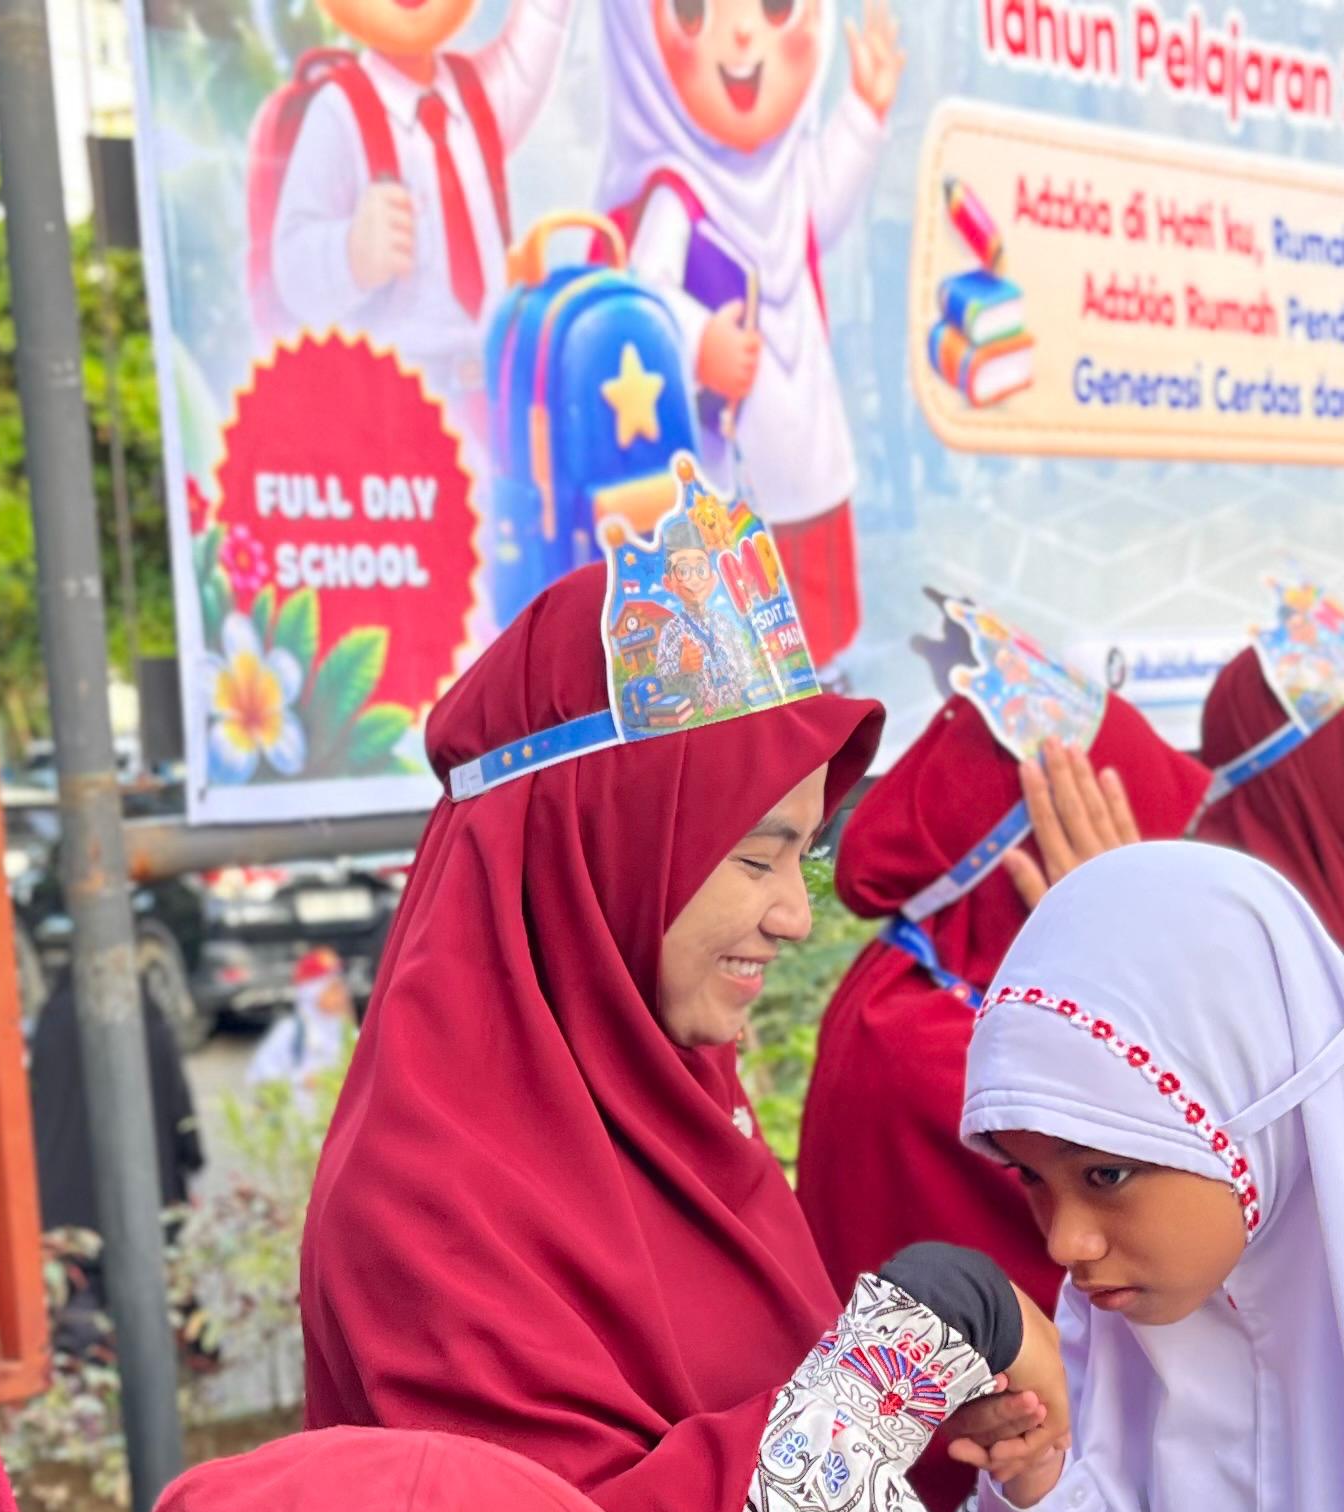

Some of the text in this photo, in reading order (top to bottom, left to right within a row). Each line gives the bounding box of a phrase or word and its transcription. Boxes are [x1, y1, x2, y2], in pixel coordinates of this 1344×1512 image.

[1137, 8, 1332, 121] Pelajaran
[1014, 175, 1112, 237] Adzkia
[1123, 191, 1146, 241] di
[1158, 198, 1215, 249] Hati
[1082, 271, 1175, 327] Adzkia
[1184, 283, 1279, 337] Rumah
[1072, 356, 1204, 408] Generasi
[1214, 367, 1300, 414] Cerdas
[254, 472, 438, 521] FULL DAY
[274, 542, 431, 590] SCHOOL
[759, 604, 783, 630] SDIT
